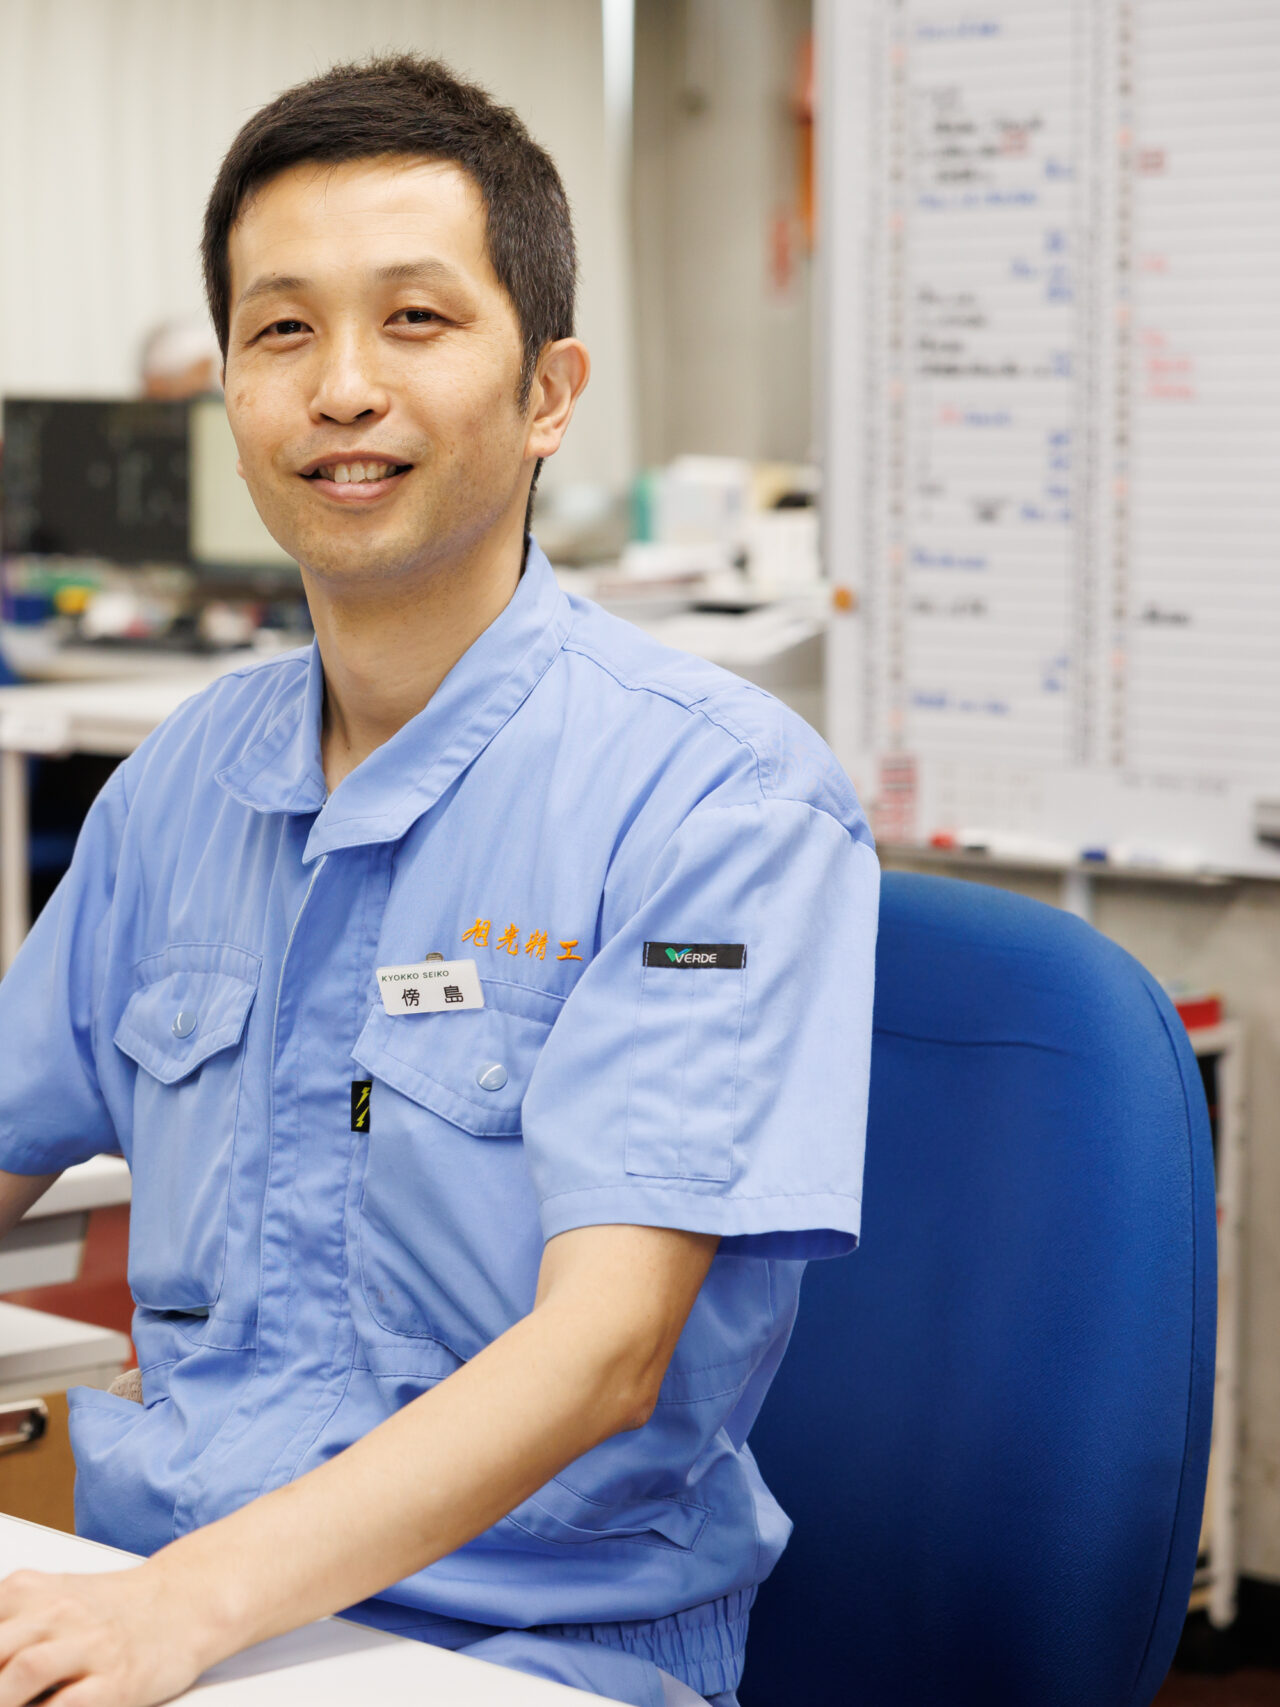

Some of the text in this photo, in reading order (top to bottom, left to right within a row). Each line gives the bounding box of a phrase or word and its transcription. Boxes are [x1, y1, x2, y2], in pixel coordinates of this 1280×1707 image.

[461, 917, 583, 961] 旭光精工
[674, 953, 718, 964] VERDE
[381, 970, 450, 982] KYOKKO SEIKO
[401, 985, 464, 1007] 傍島
